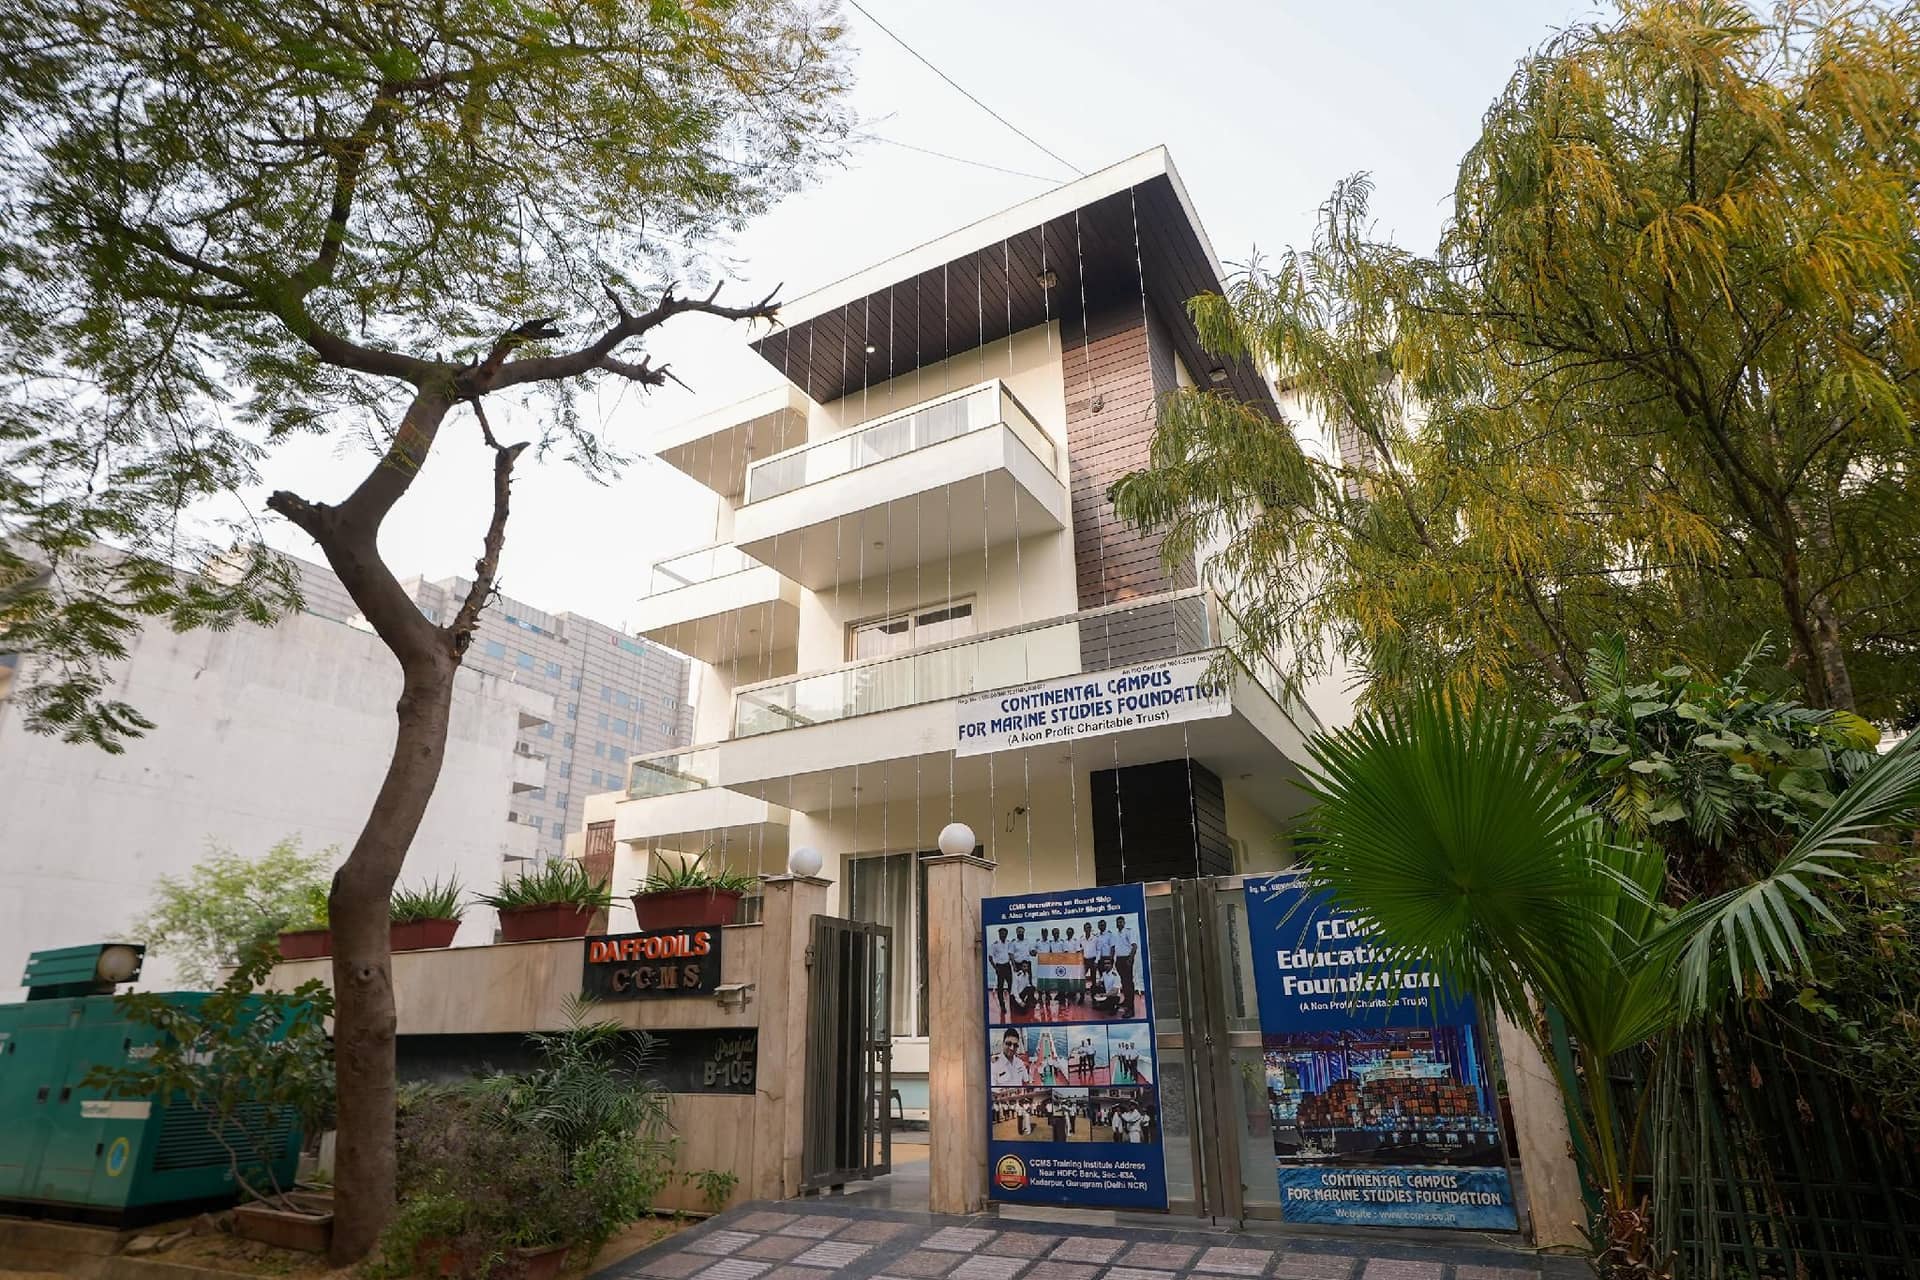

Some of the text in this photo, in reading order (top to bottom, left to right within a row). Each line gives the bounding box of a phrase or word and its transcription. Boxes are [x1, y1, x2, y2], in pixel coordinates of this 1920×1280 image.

[1001, 682, 1103, 713] CONTINENTAL
[1108, 670, 1172, 695] CAMPUS
[959, 722, 987, 741] FOR
[991, 711, 1047, 734] MARINE
[1051, 699, 1113, 724] STUDIES
[1008, 709, 1170, 746] (A Non Profit Charitable Trust)
[1300, 1001, 1309, 1013] (A
[1311, 1001, 1329, 1010] Non
[704, 1060, 753, 1087] B-105
[1029, 1159, 1146, 1170] CCMS Training Institute Address
[1039, 1169, 1055, 1177] Near
[1066, 1179, 1103, 1189] Gurugram
[1104, 1180, 1126, 1190] (Delhi
[1127, 1181, 1148, 1191] NCR)
[1321, 1174, 1458, 1189] CONTINENTAL CAMPUS
[1287, 1187, 1502, 1206] FOR MARINE STUDIES FOUNDATION
[1335, 1208, 1371, 1219] Website
